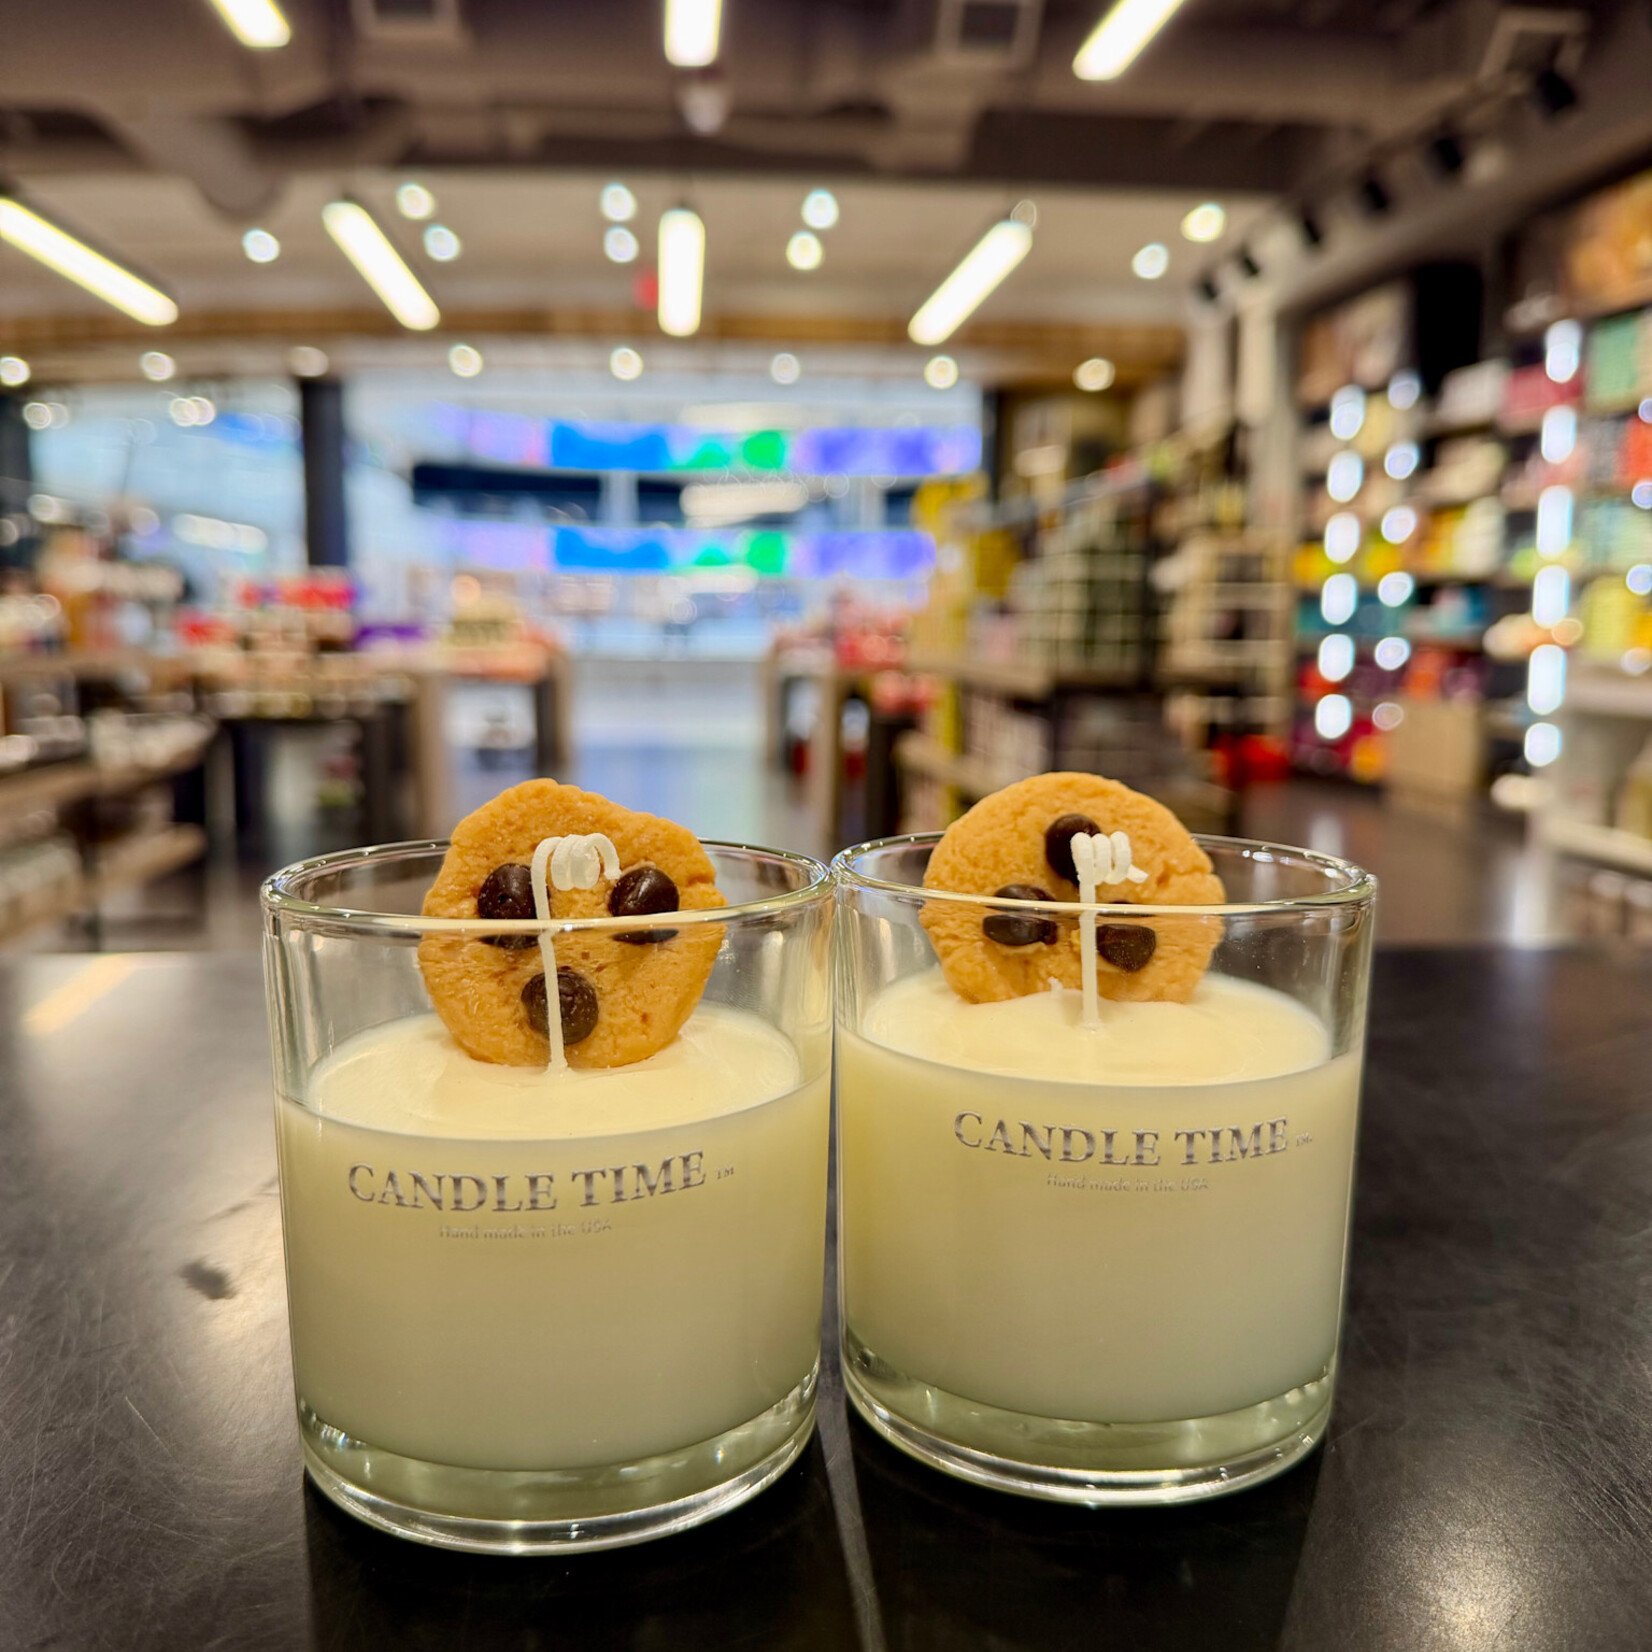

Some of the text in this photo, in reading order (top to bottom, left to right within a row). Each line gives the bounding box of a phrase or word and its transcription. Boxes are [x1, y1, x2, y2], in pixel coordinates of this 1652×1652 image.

[954, 1110, 1161, 1166] CANDLE
[1174, 1116, 1288, 1165] TIME
[349, 1162, 557, 1212] CANDLE
[571, 1150, 706, 1207] TIME
[1047, 1174, 1085, 1190] Hand
[1090, 1177, 1130, 1192] made
[1137, 1178, 1149, 1192] in
[1181, 1178, 1209, 1191] USA
[581, 1218, 612, 1235] USA
